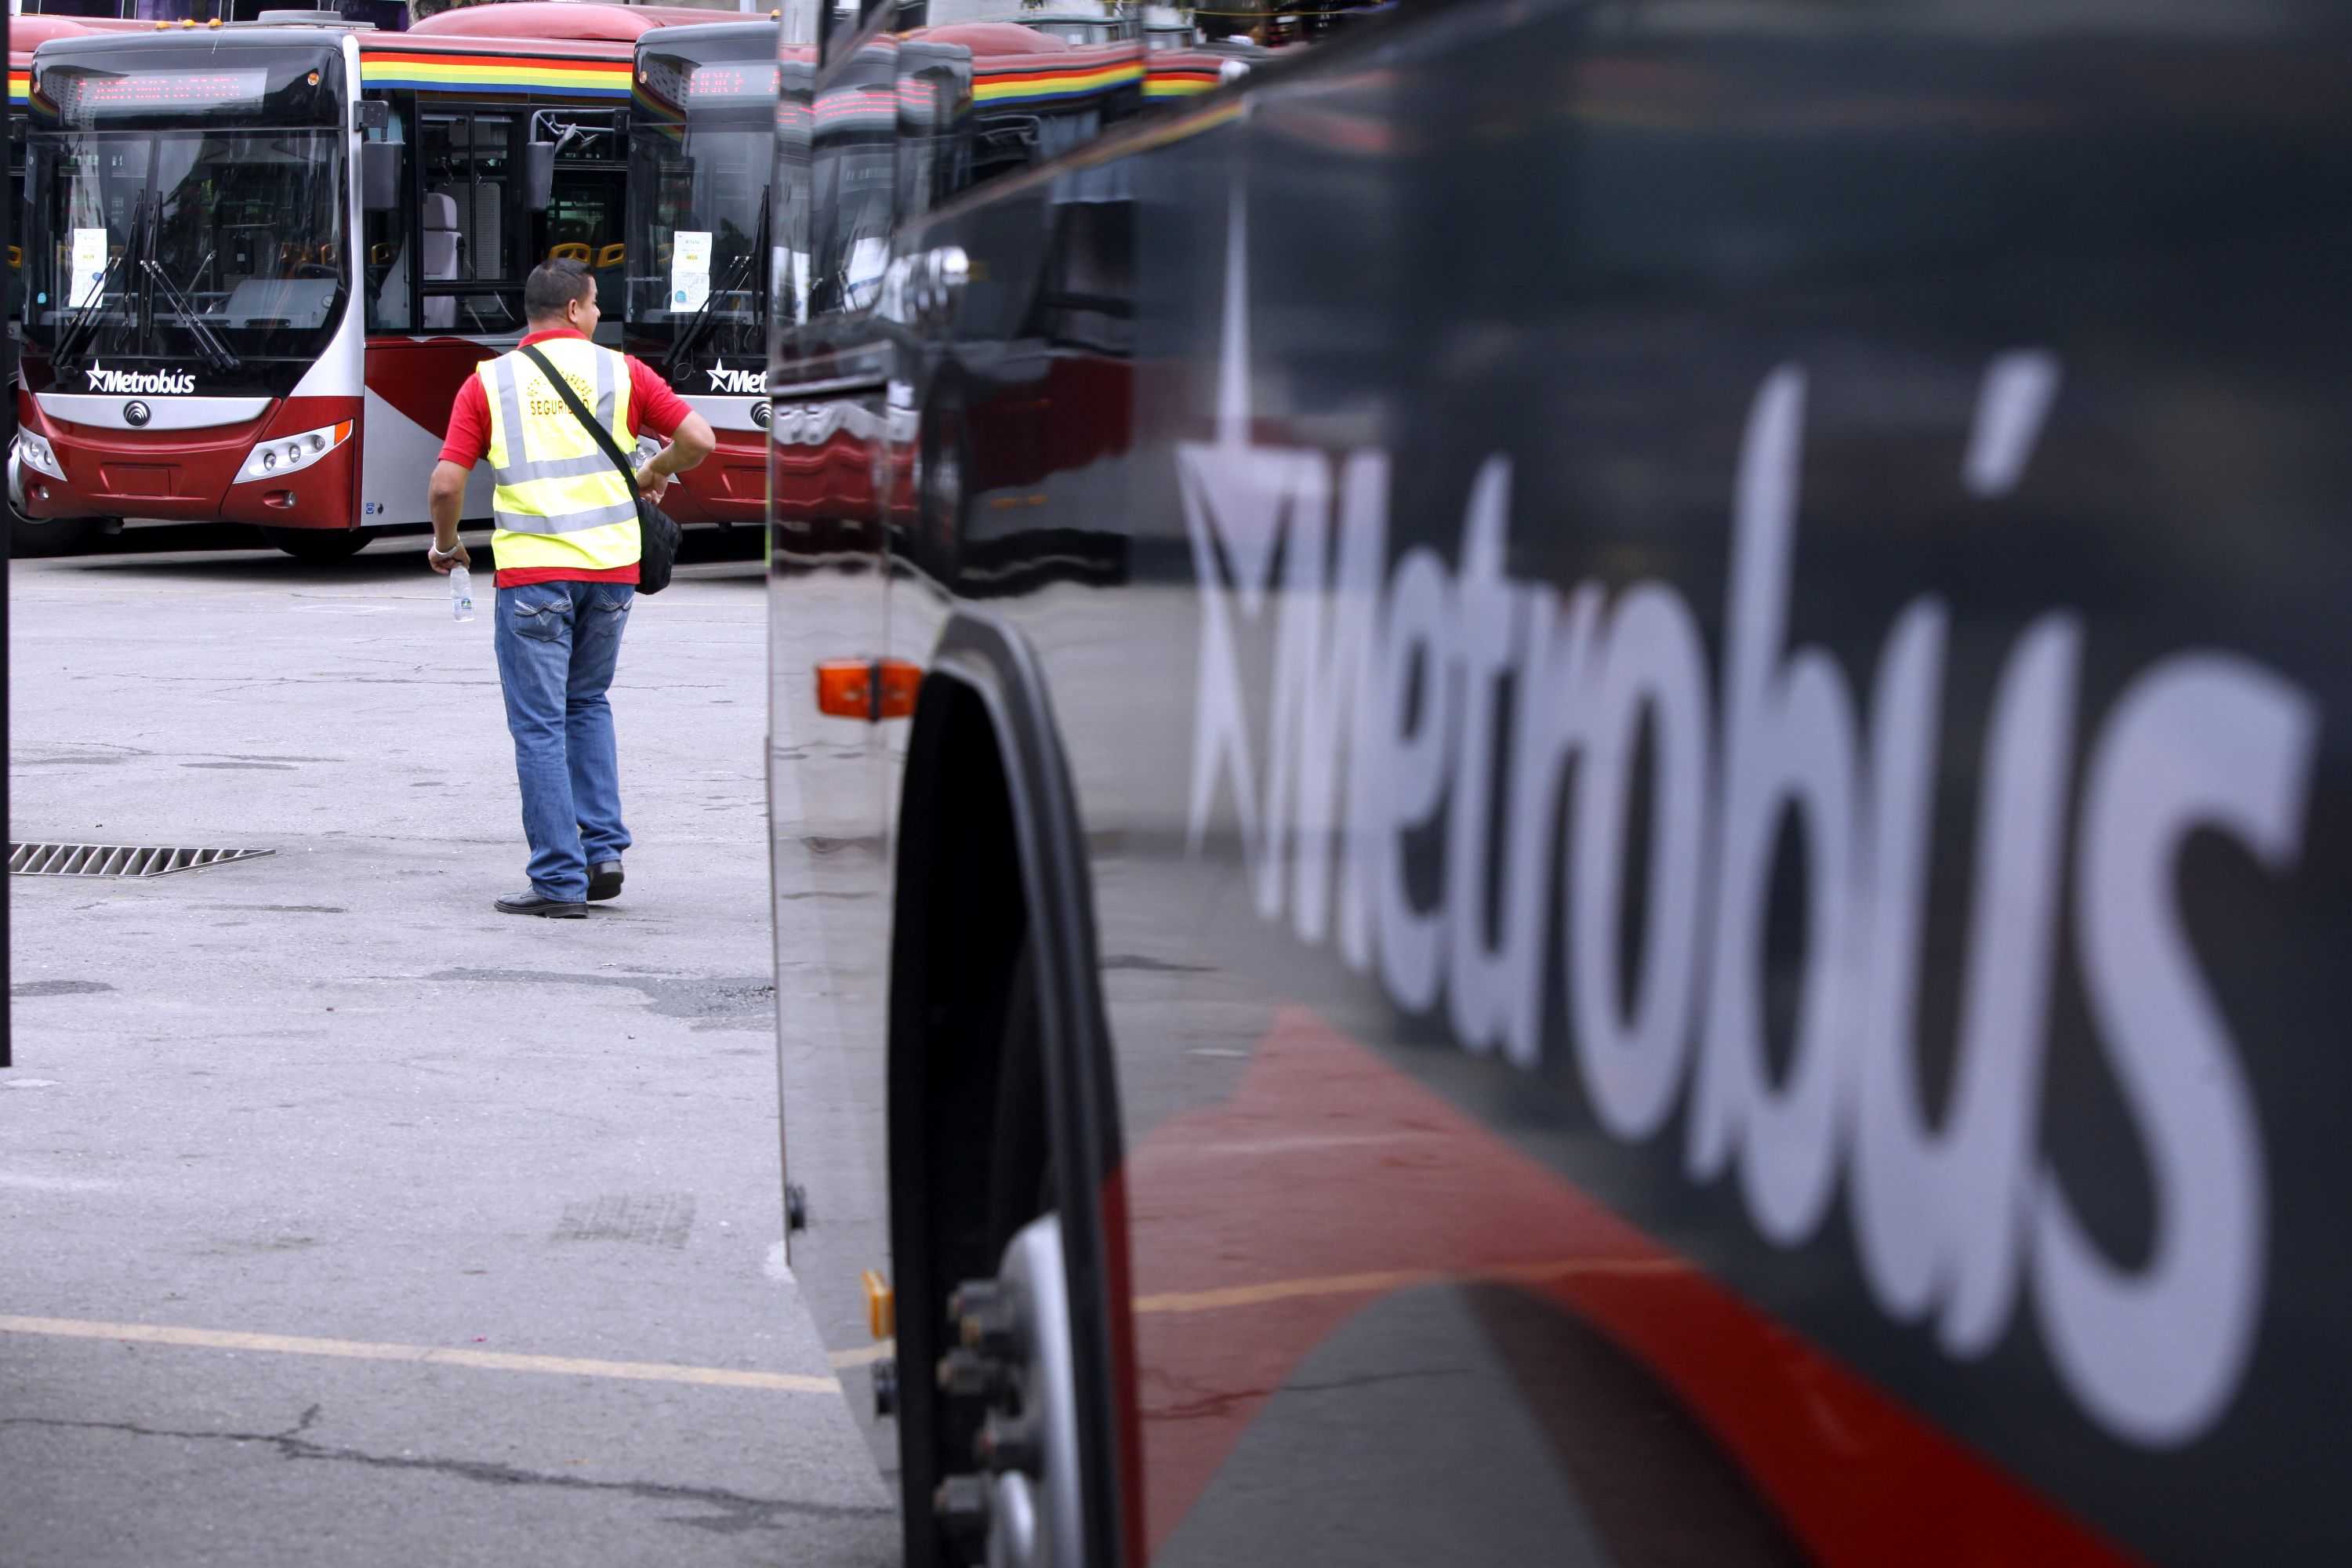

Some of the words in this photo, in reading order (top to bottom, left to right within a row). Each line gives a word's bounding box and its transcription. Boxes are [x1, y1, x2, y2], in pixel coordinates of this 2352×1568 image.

[103, 368, 196, 394] Metrobús
[530, 398, 590, 416] SEGURID
[1254, 347, 2319, 1448] Metrobús
